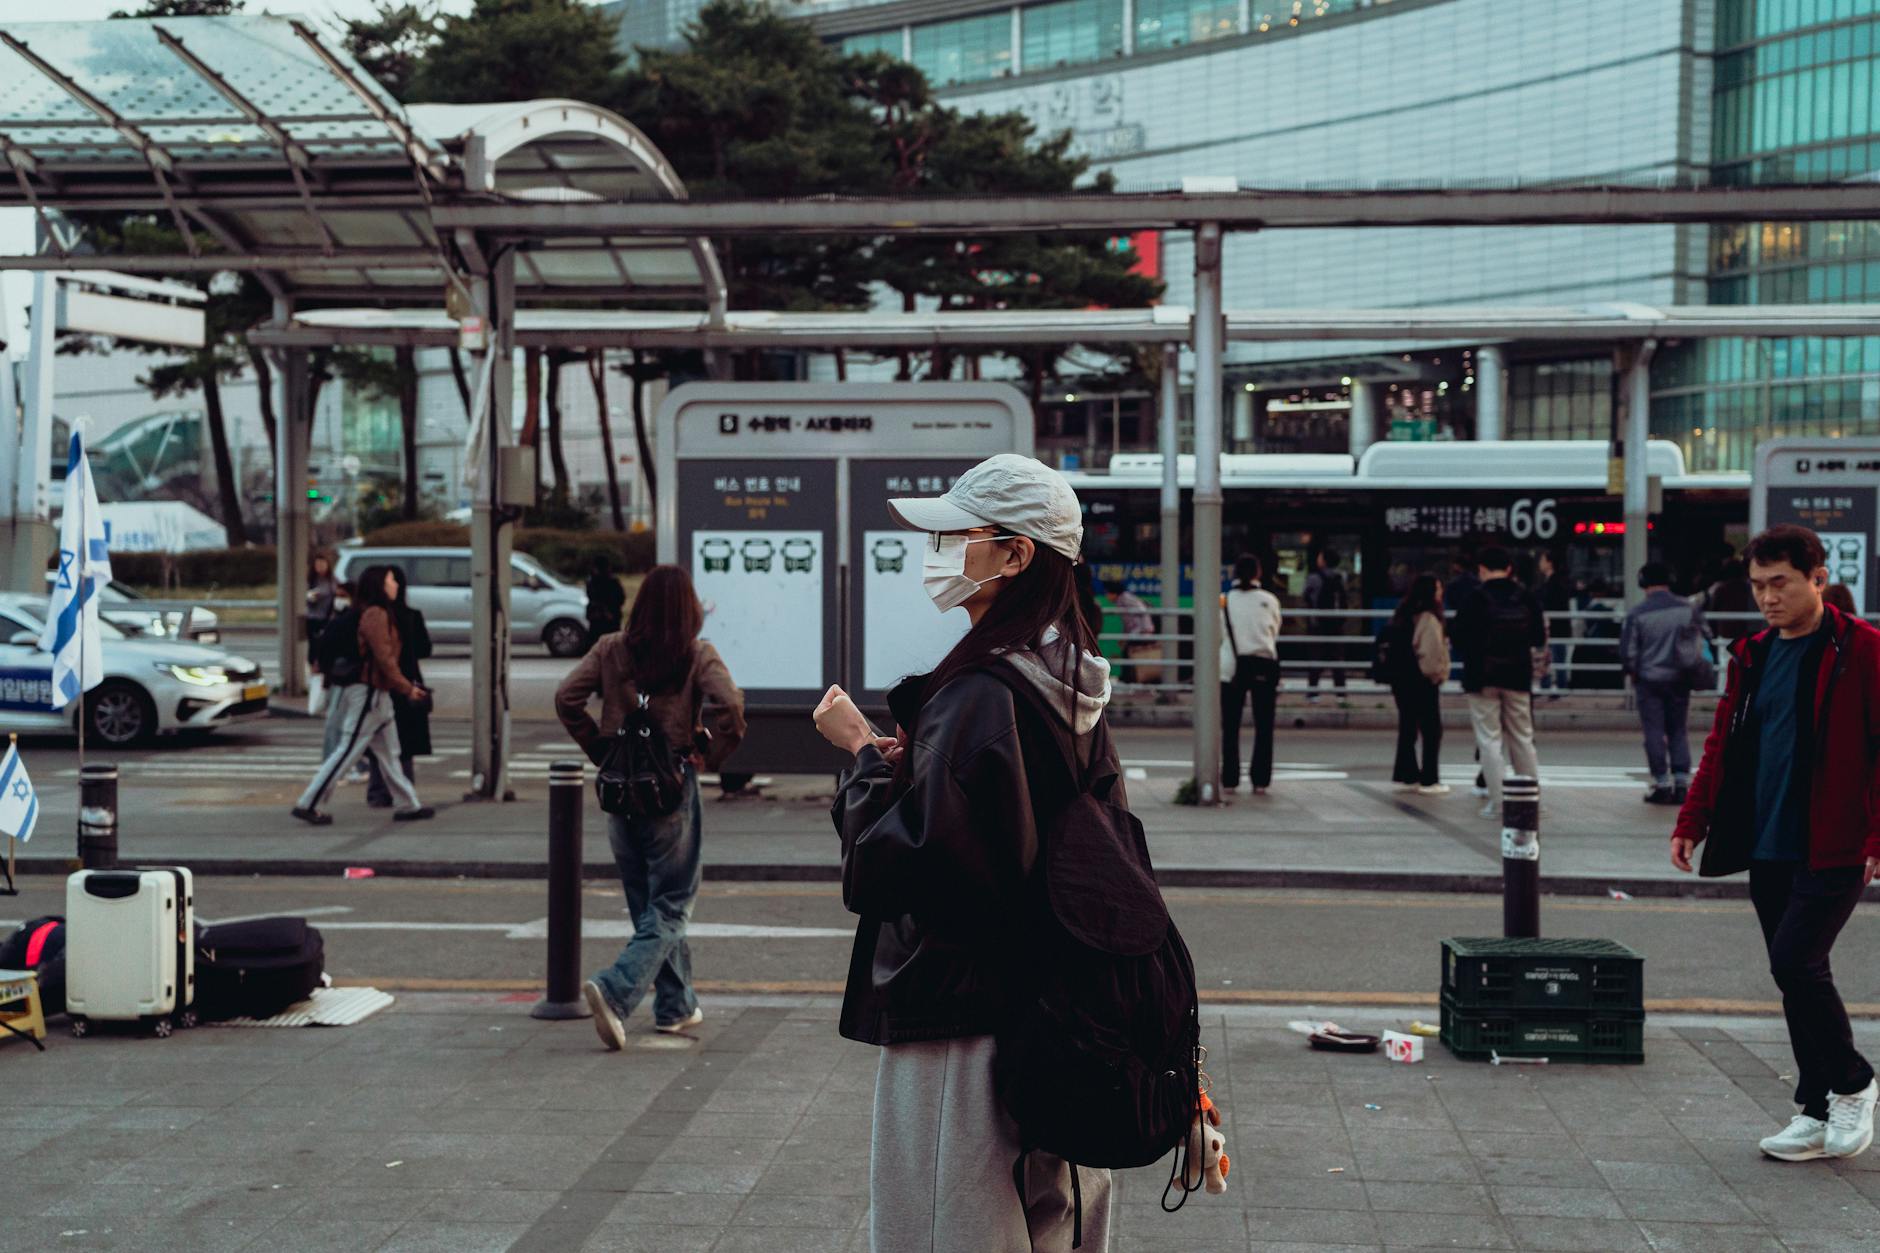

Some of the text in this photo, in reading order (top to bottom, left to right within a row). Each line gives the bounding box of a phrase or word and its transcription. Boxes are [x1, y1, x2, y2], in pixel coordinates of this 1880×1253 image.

[714, 476, 740, 492] 버스
[745, 476, 770, 492] 번호
[886, 477, 912, 492] 버스
[917, 477, 943, 492] 번호
[1509, 498, 1558, 540] 66
[0, 678, 53, 704] 일병원
